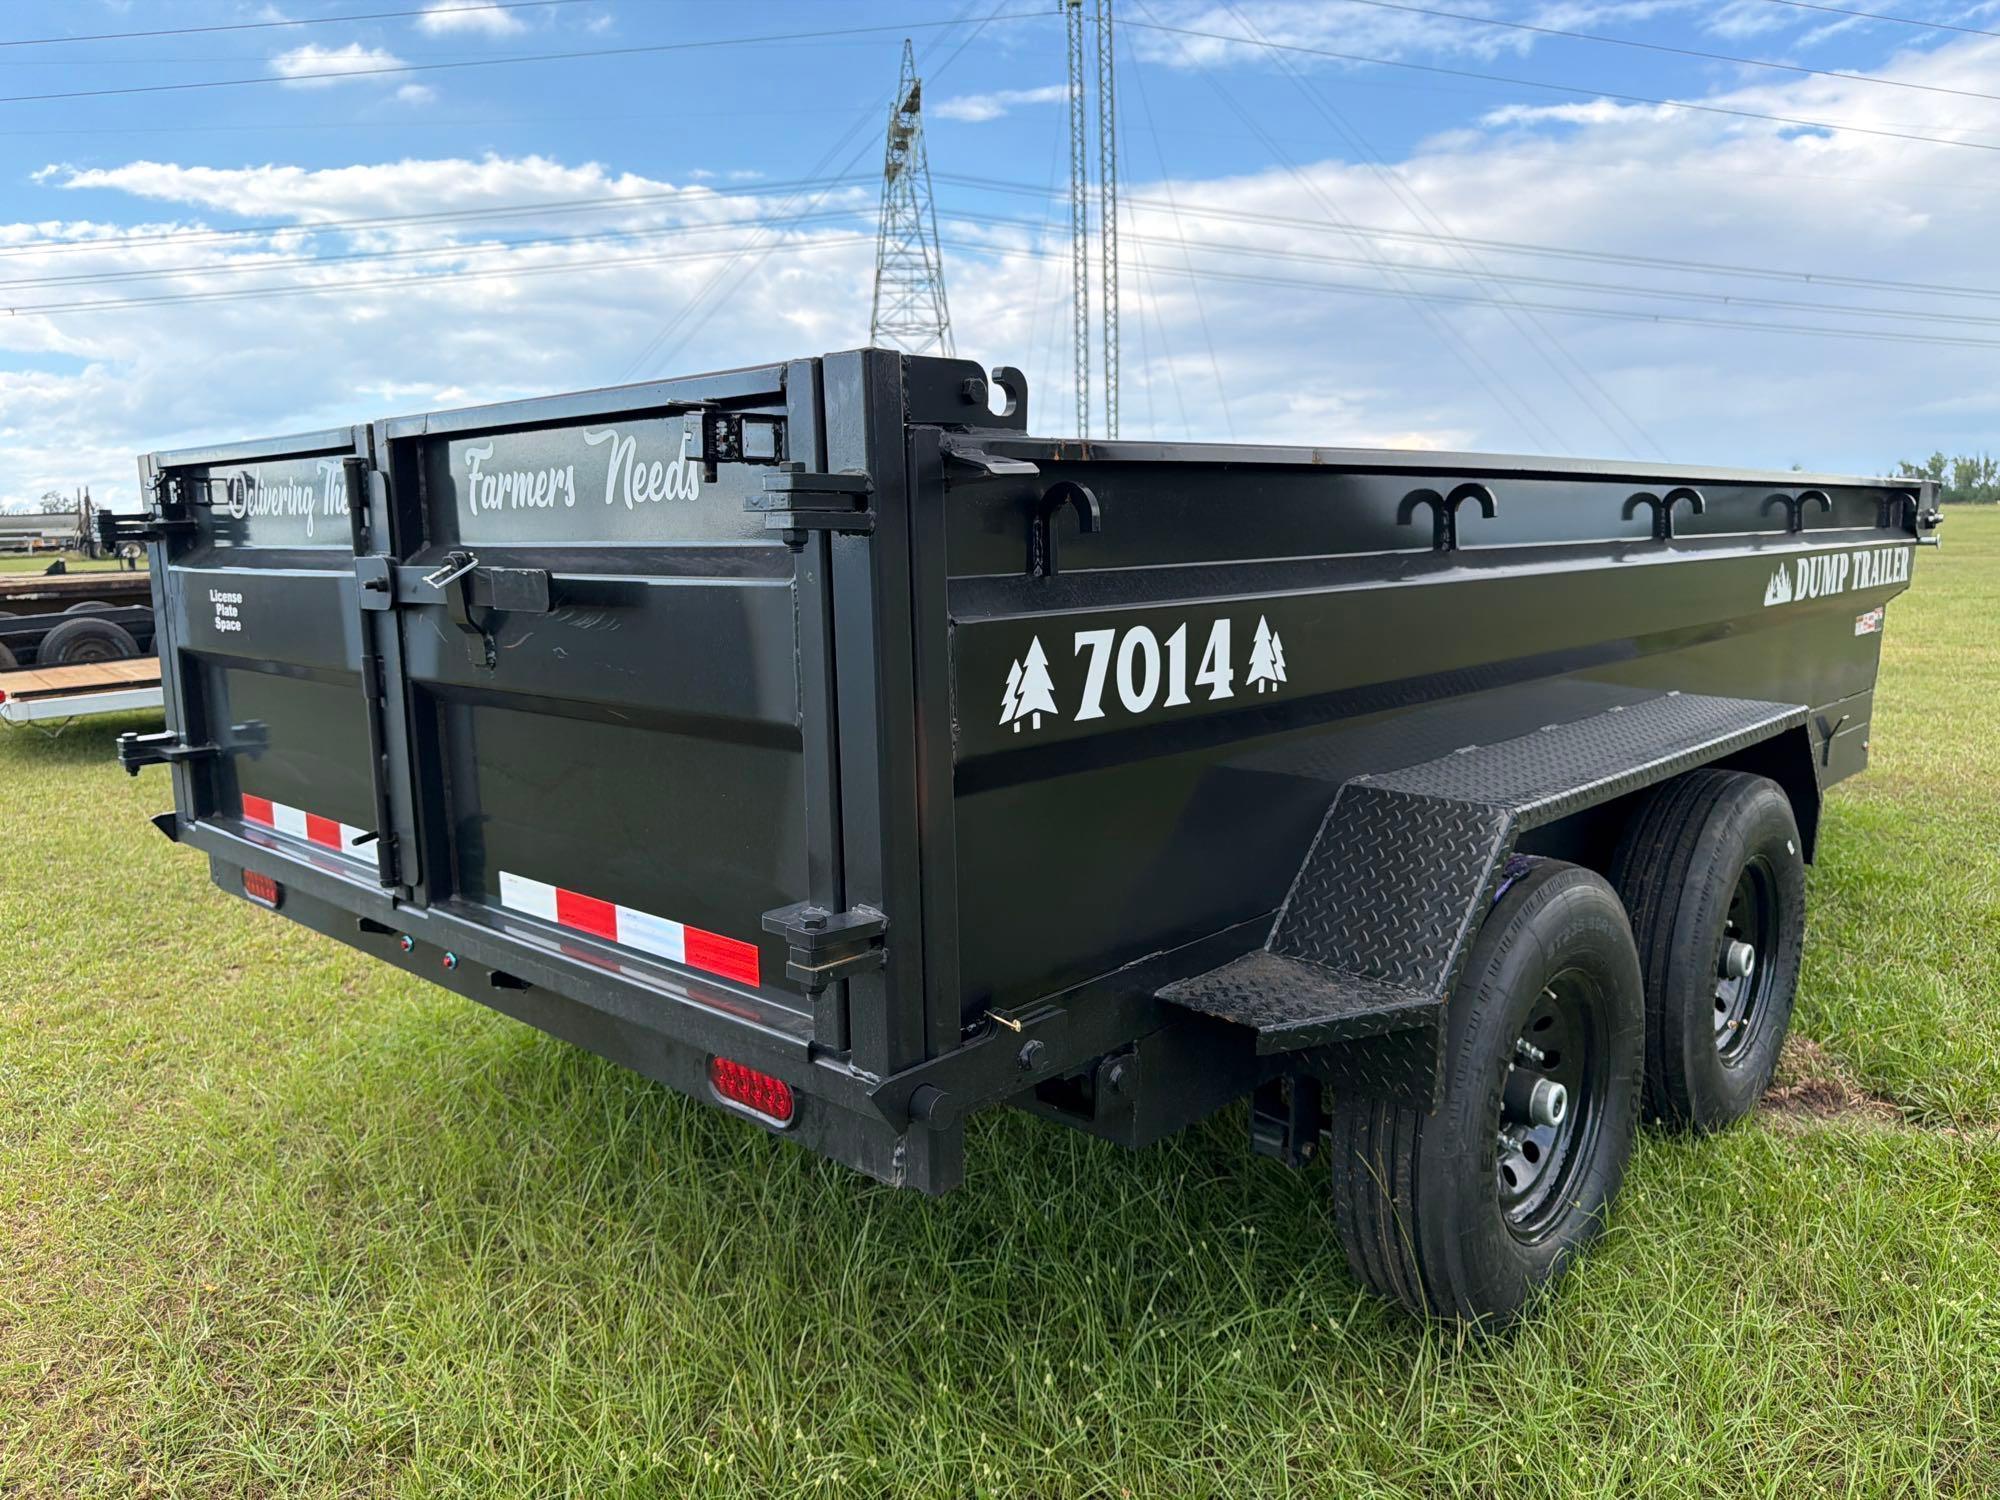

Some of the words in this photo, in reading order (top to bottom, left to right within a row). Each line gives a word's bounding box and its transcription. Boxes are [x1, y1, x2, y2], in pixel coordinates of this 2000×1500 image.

[226, 465, 316, 538] Delivering
[317, 460, 351, 516] The
[465, 441, 576, 516] Farmers
[583, 428, 699, 510] Needs
[209, 589, 243, 604] License
[1793, 553, 1849, 601] DUMP
[1851, 547, 1910, 590] TRAILER
[214, 616, 242, 633] Space
[215, 602, 239, 617] Plate
[1073, 618, 1235, 722] 7014
